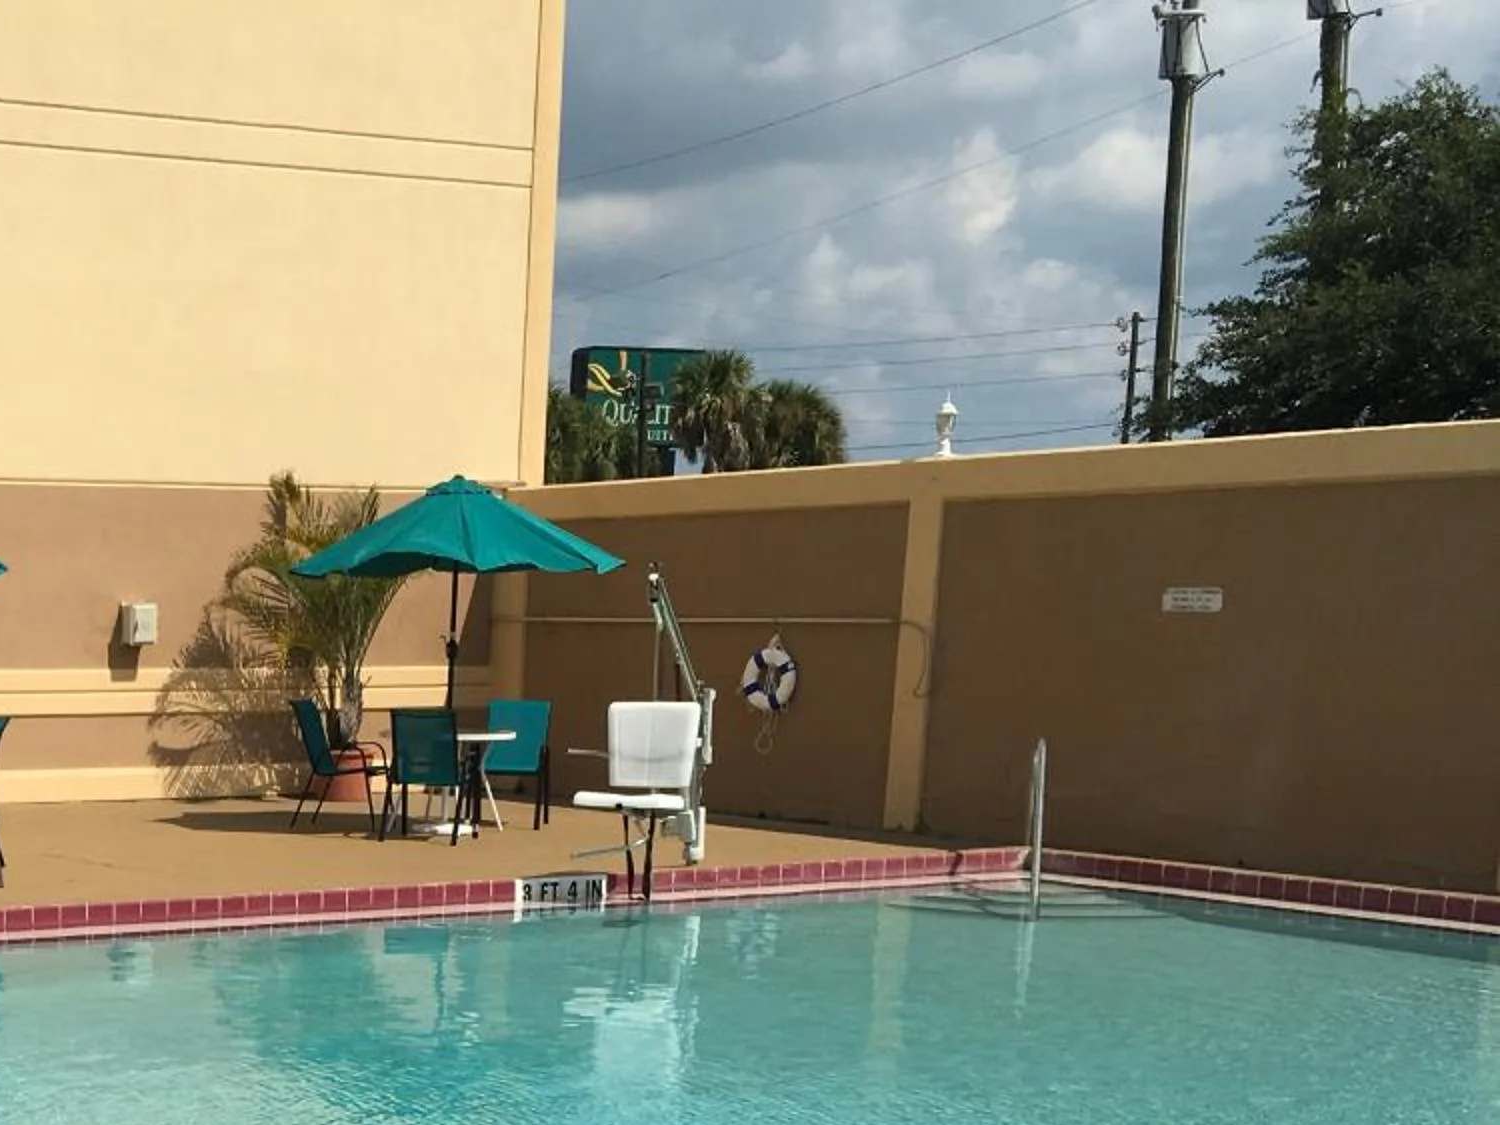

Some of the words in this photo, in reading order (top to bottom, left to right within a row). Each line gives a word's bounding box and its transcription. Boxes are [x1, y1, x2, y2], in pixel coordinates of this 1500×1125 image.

[603, 399, 675, 427] QUIT
[523, 883, 532, 901] 3
[541, 882, 559, 902] FT
[567, 881, 577, 899] 4
[586, 879, 602, 899] IN
